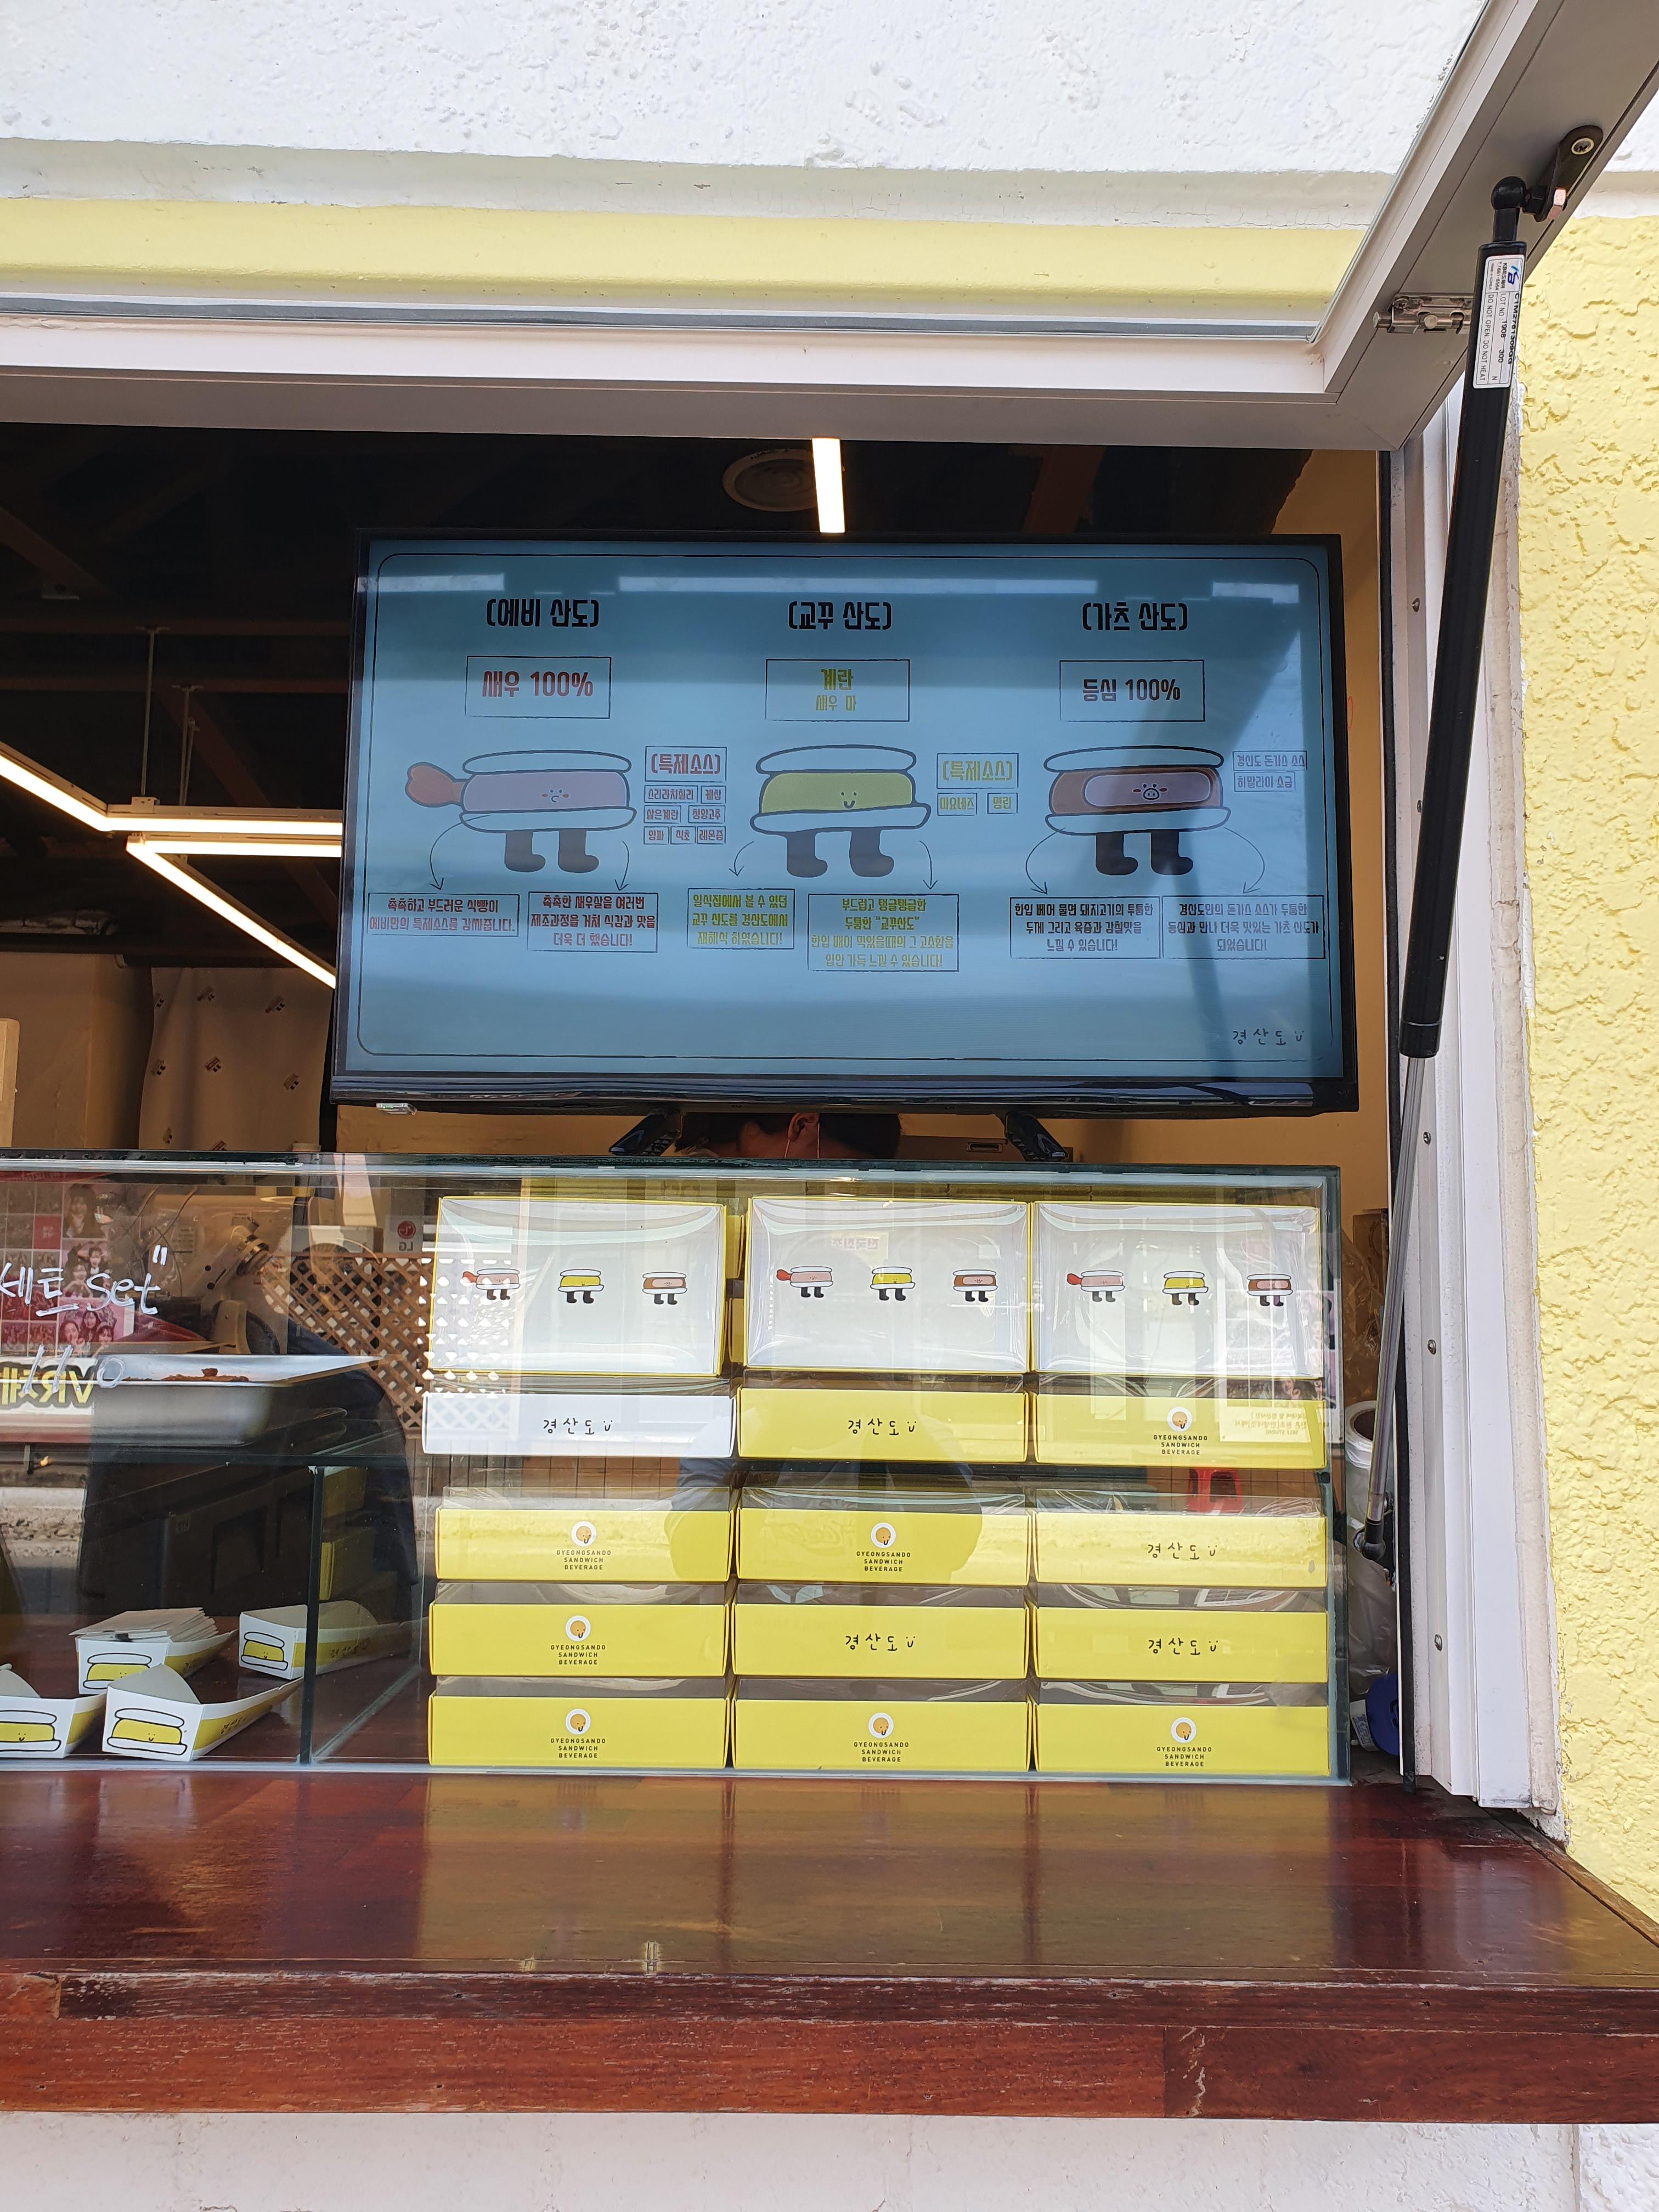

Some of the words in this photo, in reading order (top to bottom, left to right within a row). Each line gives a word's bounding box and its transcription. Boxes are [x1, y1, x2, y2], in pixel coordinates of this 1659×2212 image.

[1487, 294, 1494, 303] DO
[1482, 340, 1489, 349] DO
[482, 670, 520, 697] 새우
[530, 671, 594, 697] 100%
[821, 668, 854, 691] 계란
[1083, 679, 1116, 702] 등심
[1125, 679, 1181, 701] 100%
[816, 695, 838, 712] 새우
[845, 695, 857, 712] 마
[651, 753, 720, 774] (특제소스)
[1237, 754, 1261, 767] 경산도
[1264, 754, 1288, 767] 돈가스
[1291, 754, 1305, 767] 소스
[943, 760, 1012, 781] (특제소스)
[1238, 776, 1274, 788] 히말라야
[1277, 776, 1293, 788] 소금
[940, 797, 974, 810] 마요네즈
[993, 796, 1011, 810] 명란
[692, 809, 721, 820] 청양고추
[648, 830, 664, 841] 양파
[676, 830, 690, 841] 식초
[388, 898, 424, 912] 촉촉하고
[428, 899, 463, 912] 부드러운
[467, 899, 498, 913] 식빵이
[543, 895, 571, 909] 촉촉한
[575, 896, 612, 909] 새우살을
[616, 896, 645, 910] 여러번
[693, 894, 741, 908] 일식집에서
[745, 895, 754, 908] 볼
[758, 895, 765, 908] 수
[769, 895, 787, 908] 있던
[842, 898, 874, 911] 부드럽고
[1015, 903, 1033, 916] 한입
[1059, 904, 1076, 916] 물면
[1080, 904, 1124, 916] 돼지고기의
[1180, 904, 1223, 916] 경산도만의
[1227, 904, 1251, 916] 돈가스
[1255, 904, 1278, 916] 소스가
[1281, 903, 1308, 916] 두툼한
[370, 917, 409, 930] 에비만의
[413, 917, 458, 931] 특제소스를
[531, 913, 579, 927] 제조과정을
[604, 915, 633, 928] 식감과
[637, 915, 655, 928] 맛을
[692, 913, 708, 926] 교꾸
[711, 913, 737, 926] 산도를
[742, 913, 788, 927] 경산도에서
[845, 917, 871, 930] 두툼한
[1047, 921, 1071, 934] 그리고
[1074, 921, 1102, 934] 육즙과
[1105, 921, 1142, 934] 감칠맛을
[1168, 921, 1195, 934] 등심과
[1199, 921, 1217, 934] 만나
[1221, 921, 1239, 934] 더욱
[1243, 921, 1271, 934] 맛있는
[1274, 921, 1290, 934] 가츠
[1293, 921, 1319, 934] 산도가
[553, 933, 572, 946] 더욱
[576, 933, 585, 946] 더
[697, 932, 728, 945] 재해석
[731, 932, 782, 945] 하였습니다!
[811, 935, 830, 949] 한입
[910, 935, 916, 949] 그
[920, 935, 953, 949] 고소함을
[1047, 939, 1064, 952] 느낄
[1068, 939, 1074, 952] 수
[1078, 939, 1118, 952] 있습니다!
[825, 954, 845, 967] 입안
[848, 954, 866, 967] 가득
[870, 954, 887, 967] 느낄
[890, 955, 898, 967] 수
[901, 954, 943, 967] 있습니다!
[1233, 1028, 1286, 1046] 경산도
[543, 1418, 595, 1435] 경산도
[848, 1418, 899, 1435] 경산도
[1148, 1542, 1200, 1560] 경산도
[845, 1633, 898, 1651] 경산도
[1148, 1637, 1201, 1656] 경산도
